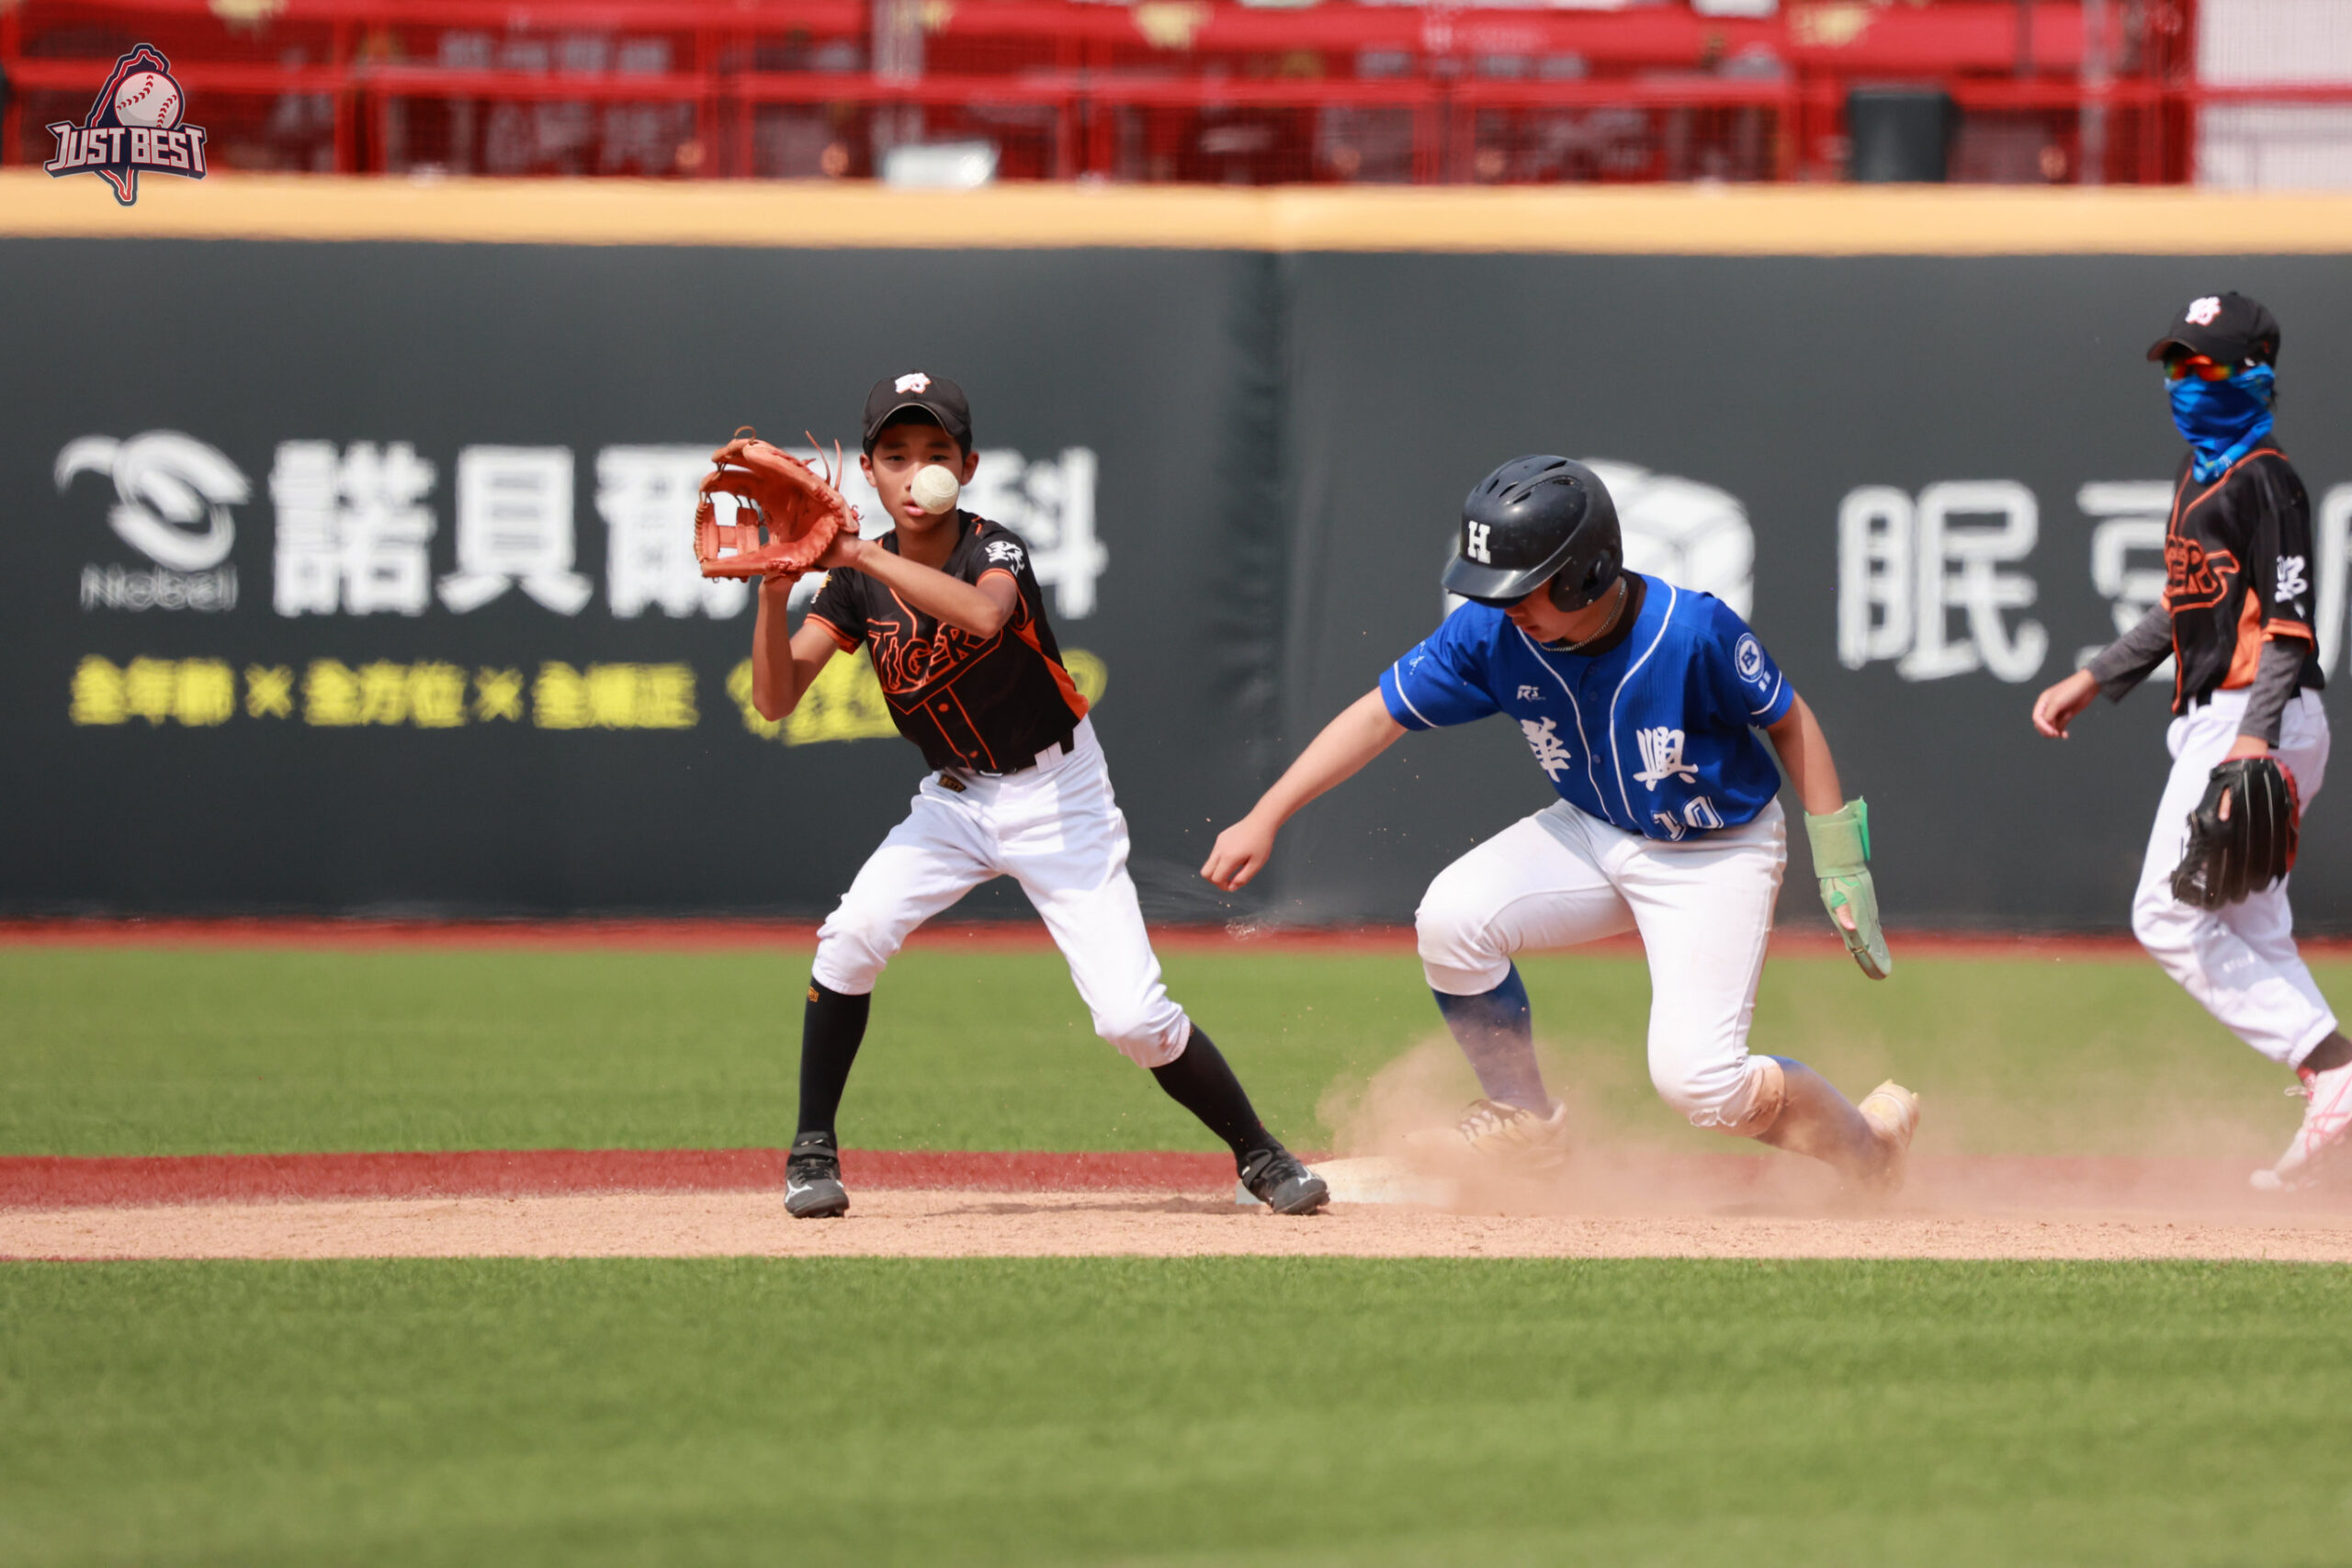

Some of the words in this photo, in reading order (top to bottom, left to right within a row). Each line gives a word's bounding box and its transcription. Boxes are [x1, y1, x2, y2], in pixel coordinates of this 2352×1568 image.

[269, 439, 1108, 619] 諾貝爾科
[1468, 520, 1490, 564] H
[866, 617, 1001, 694] TIGER
[1652, 795, 1724, 840] 10
